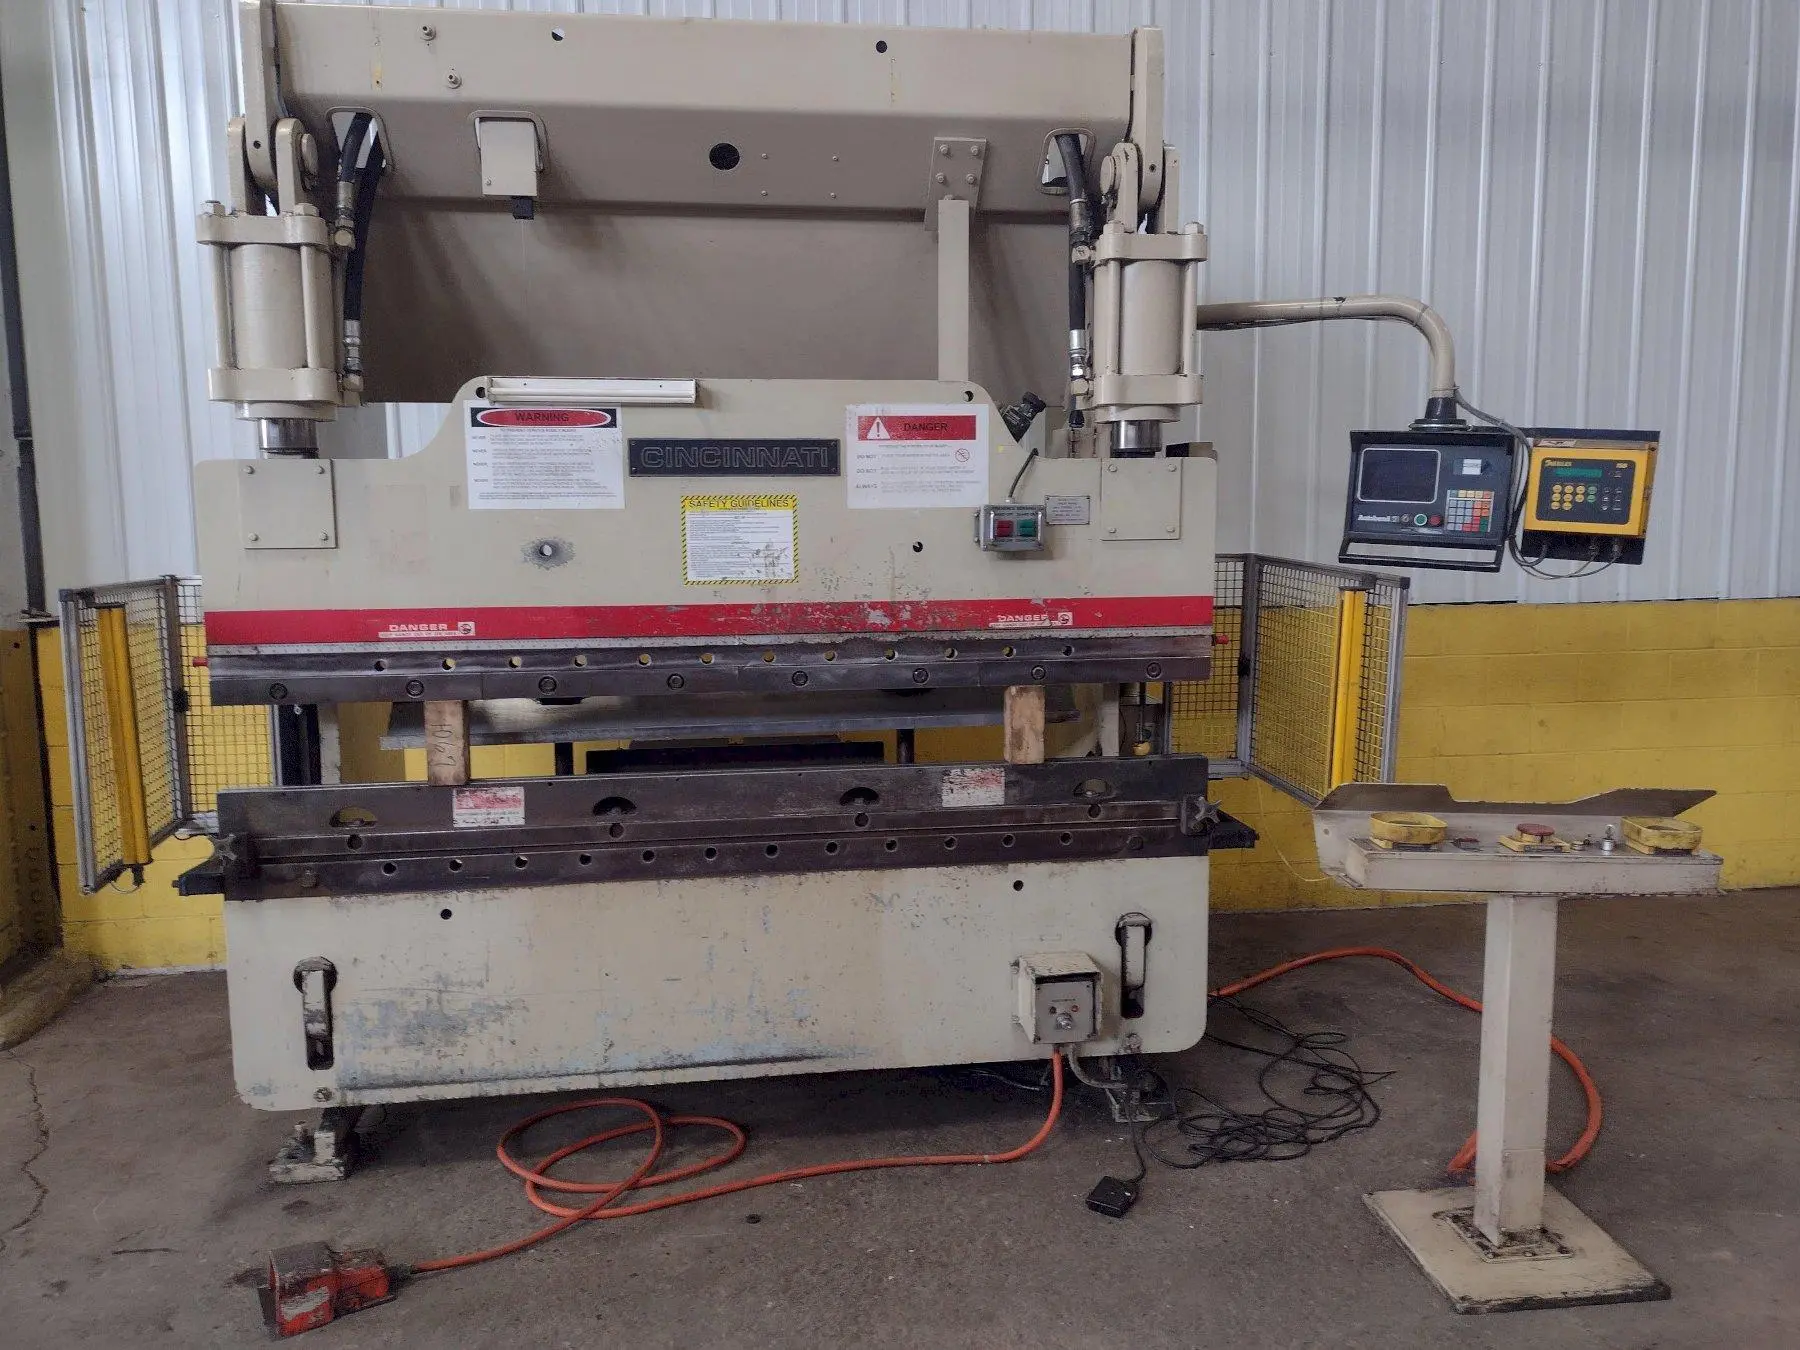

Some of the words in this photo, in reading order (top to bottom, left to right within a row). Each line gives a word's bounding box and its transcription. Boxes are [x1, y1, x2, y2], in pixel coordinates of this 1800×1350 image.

[514, 412, 570, 422] WARNING
[903, 422, 948, 431] DANGER
[640, 446, 829, 468] CINCINNATI
[689, 500, 727, 508] SAFETY
[730, 499, 789, 508] GUIDELINES
[388, 623, 448, 632] DANGER
